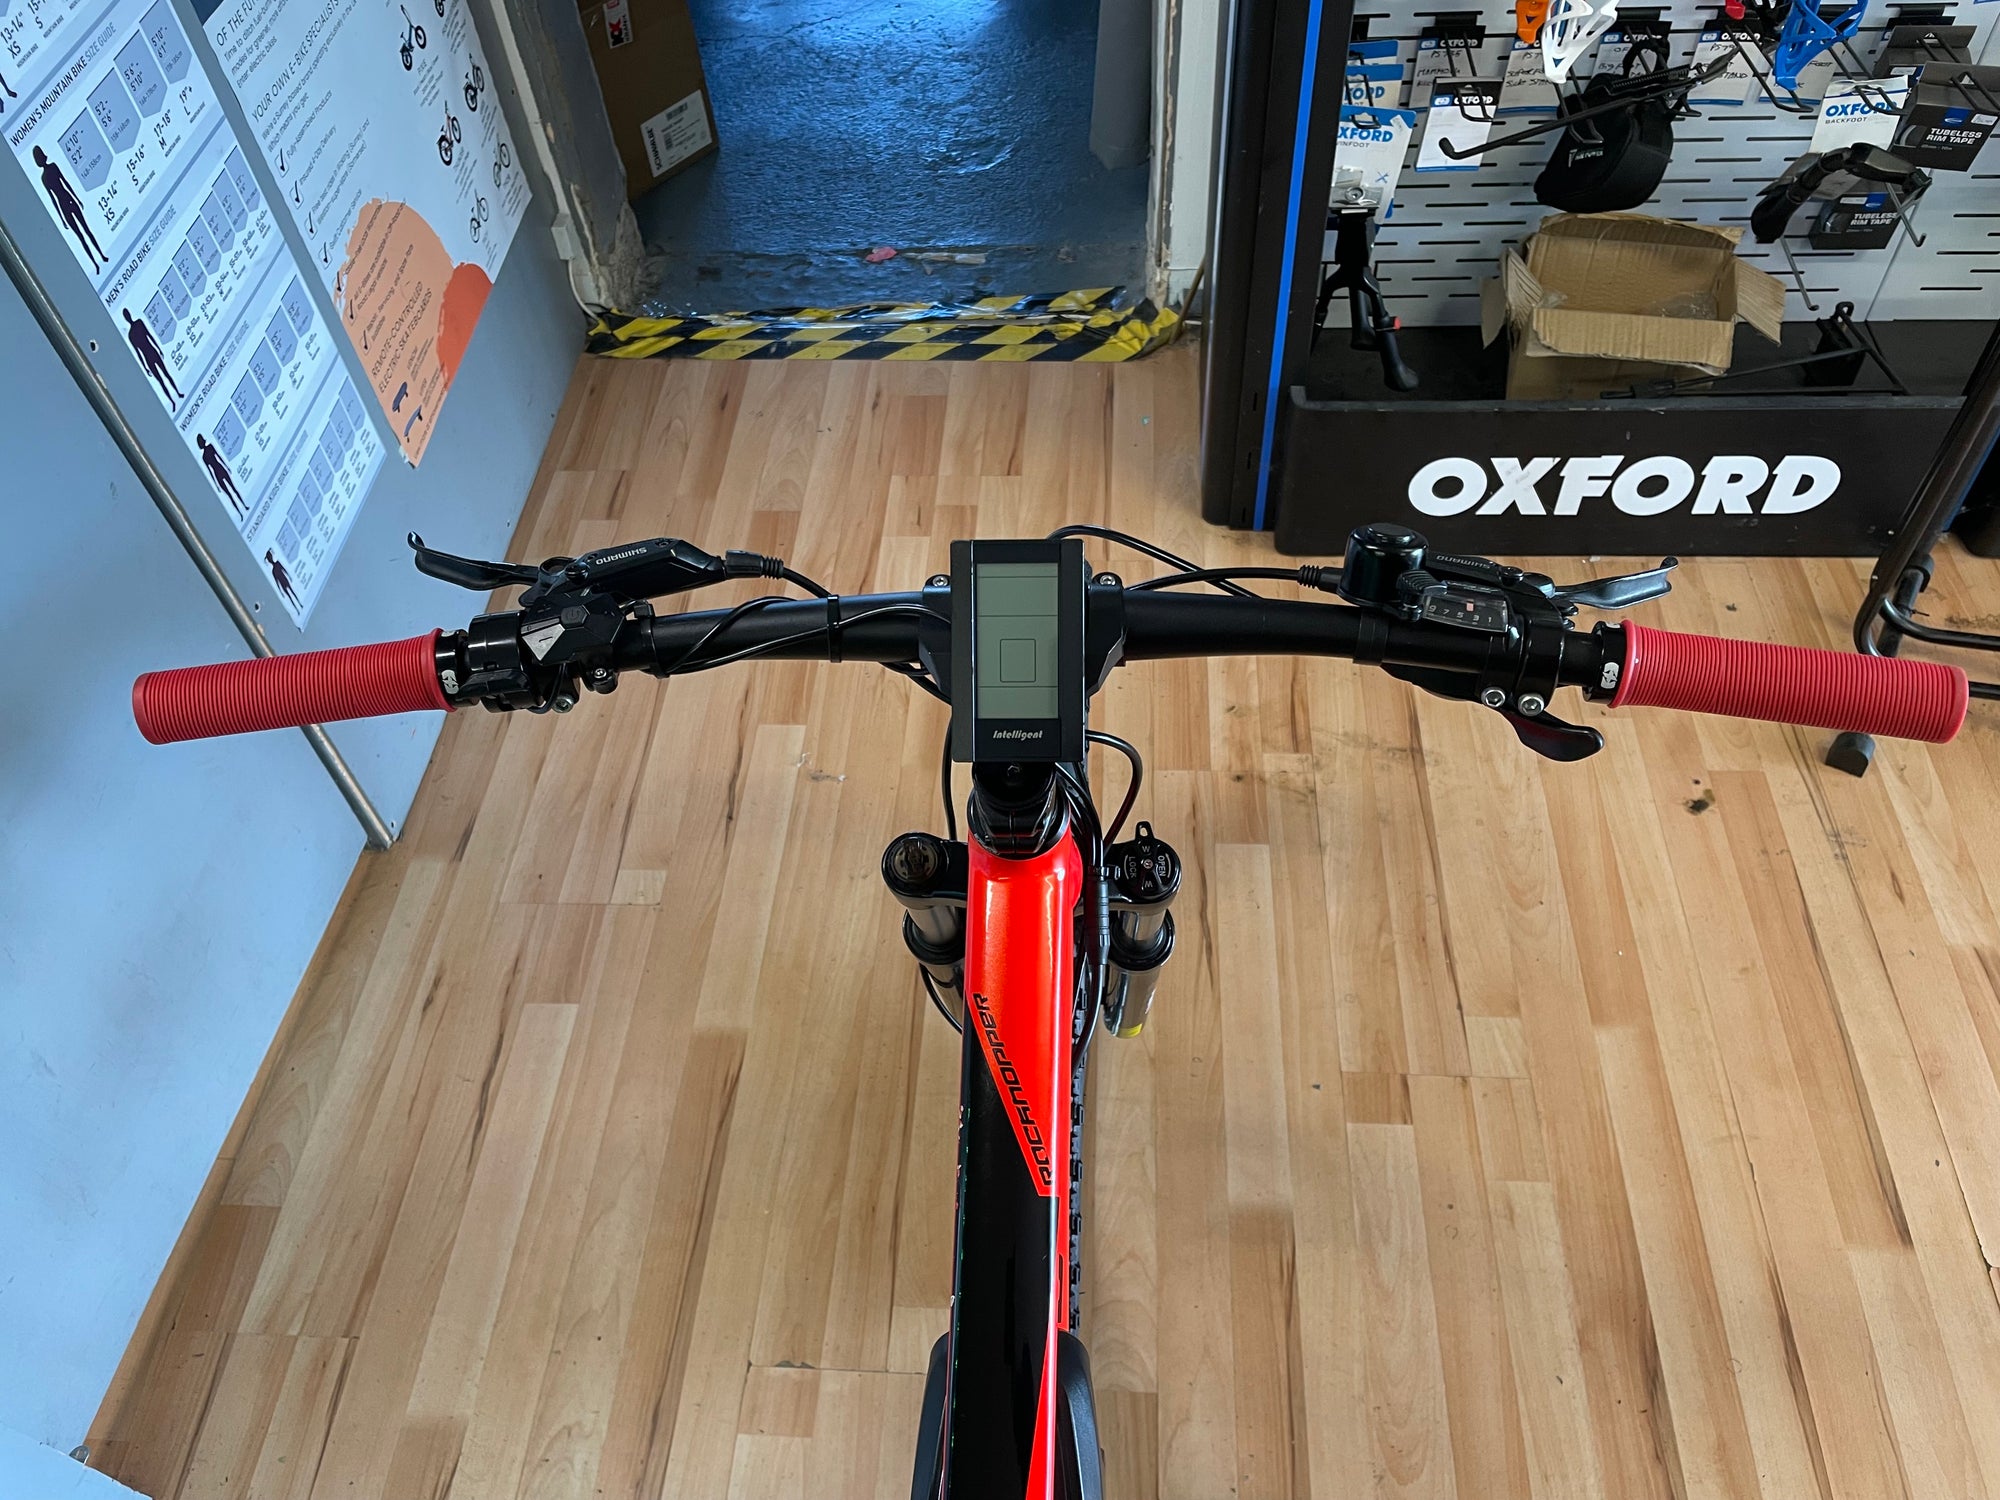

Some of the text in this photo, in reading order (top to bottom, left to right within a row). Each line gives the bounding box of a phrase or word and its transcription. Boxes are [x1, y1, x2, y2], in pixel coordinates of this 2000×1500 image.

[34, 14, 44, 30] S
[215, 7, 244, 48] OF THE
[7, 39, 22, 60] XS
[223, 19, 255, 63] Time to ditch
[230, 50, 248, 77] modes
[245, 42, 254, 57] for
[247, 45, 266, 75] electric
[9, 20, 117, 150] WOMEN'S MOUNTAIN BIKE SIZE GUIDE
[251, 90, 273, 125] YOUR
[270, 66, 290, 100] OWN
[287, 39, 309, 76] E-BIKE
[274, 97, 289, 123] Surrey
[287, 80, 302, 105] based
[300, 64, 313, 86] brand
[183, 103, 190, 117] L
[1825, 117, 1868, 125] BACKFOOT
[158, 135, 167, 151] M
[1926, 134, 1976, 145] RIM TAPE
[1930, 127, 1983, 139] TUBELESS
[131, 173, 139, 187] S
[103, 205, 116, 225] XS
[104, 203, 176, 308] MEN'S ROAD BIKE SIZE GUIDE
[370, 276, 424, 381] REMOTE-CONTROLLED
[377, 347, 401, 395] ELECTRIC
[398, 283, 433, 354] SKATEBOARDS
[179, 392, 204, 433] WOMEN'S
[201, 372, 216, 398] ROAD
[213, 354, 227, 378] BIKE
[224, 339, 237, 361] SIZE
[1408, 455, 1841, 517] OXFORD
[246, 498, 270, 543] STANDARD
[268, 481, 280, 503] KIDS
[277, 464, 289, 487] BIKE
[595, 546, 648, 565] SHIMANO
[1436, 555, 1491, 569] SHIMANO
[992, 729, 1044, 741] Intelligent
[1128, 856, 1137, 878] LOCK
[1157, 855, 1167, 877] OPEN
